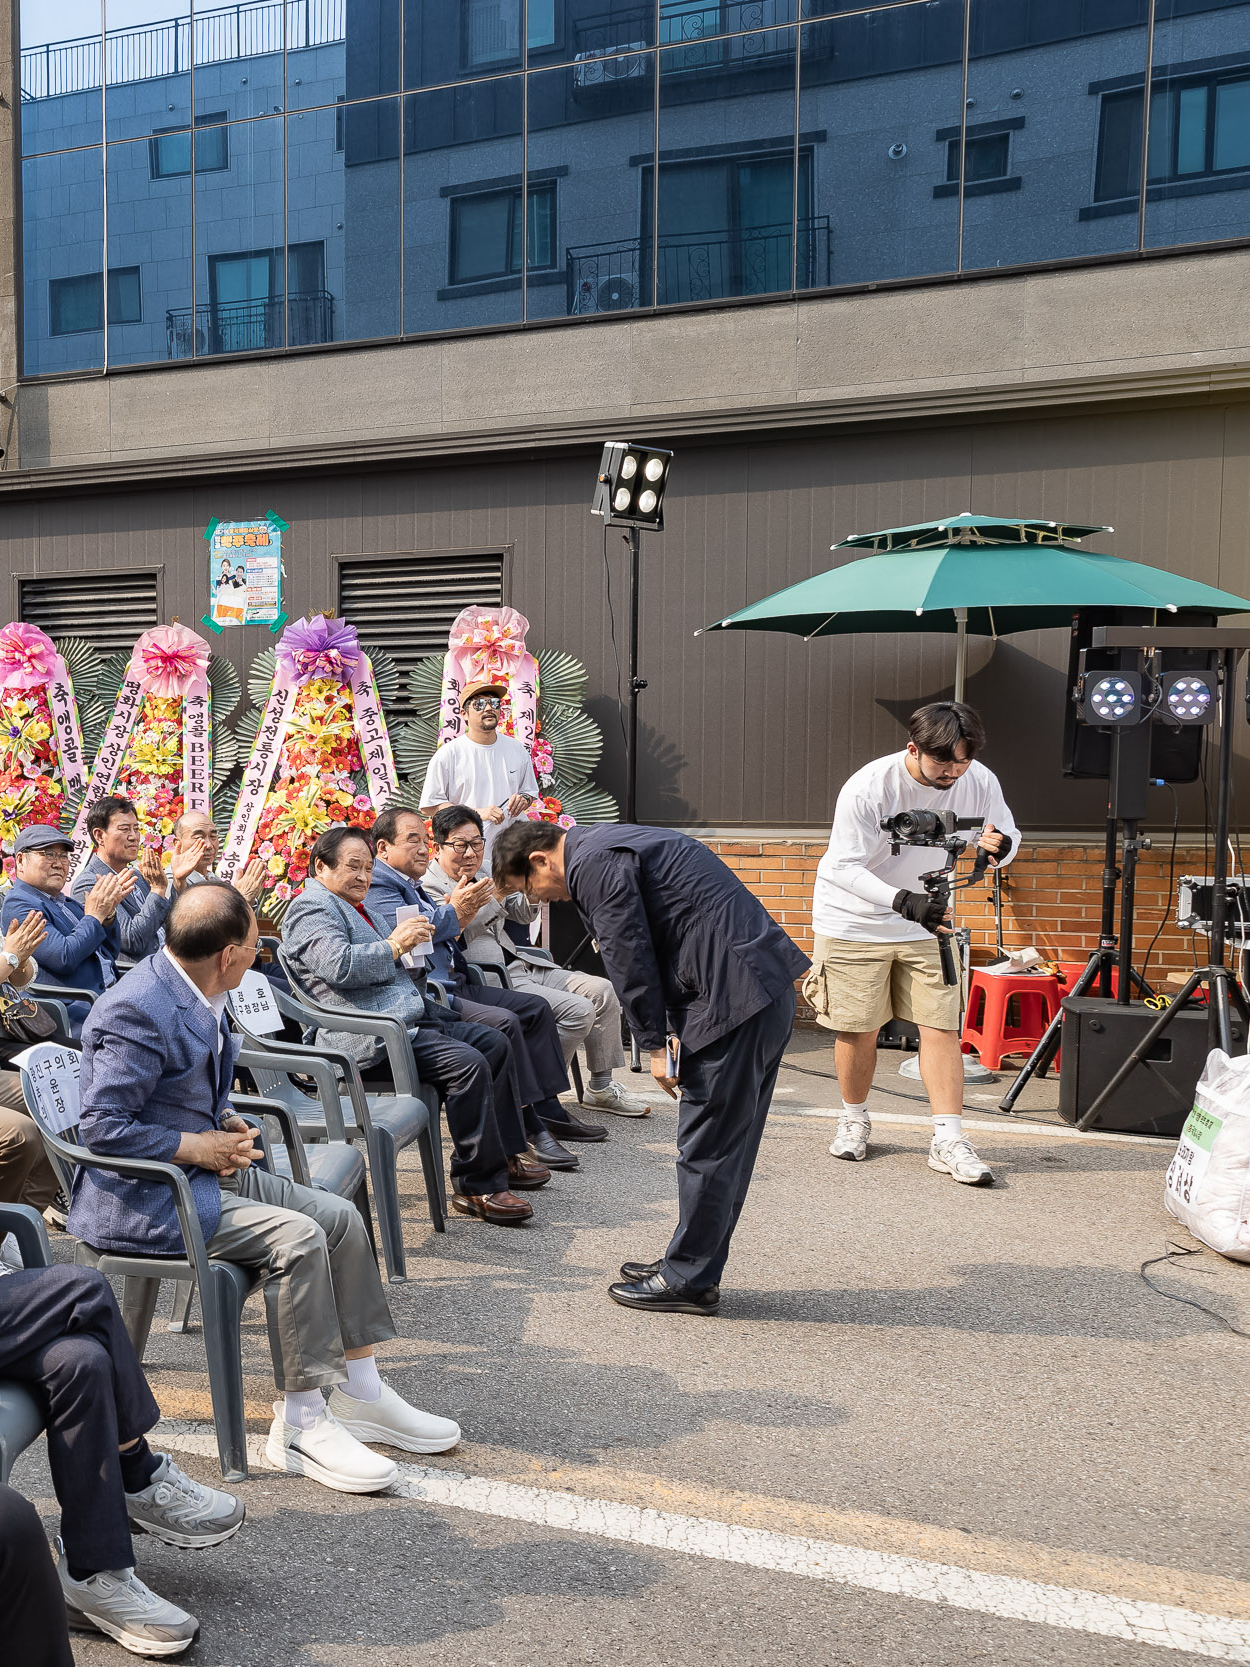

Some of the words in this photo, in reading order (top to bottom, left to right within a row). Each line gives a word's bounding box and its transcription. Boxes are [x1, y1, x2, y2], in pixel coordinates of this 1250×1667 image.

[53, 683, 69, 708] 축
[111, 680, 141, 738] 평화시장
[188, 695, 207, 709] 축
[356, 680, 372, 698] 축
[518, 681, 536, 699] 축
[58, 710, 79, 764] 앵콜
[188, 712, 208, 738] 앵콜
[245, 689, 289, 796] 신성전통시장
[189, 742, 205, 793] BEER
[359, 707, 393, 812] 중고제일시
[234, 802, 255, 846] 상인회장
